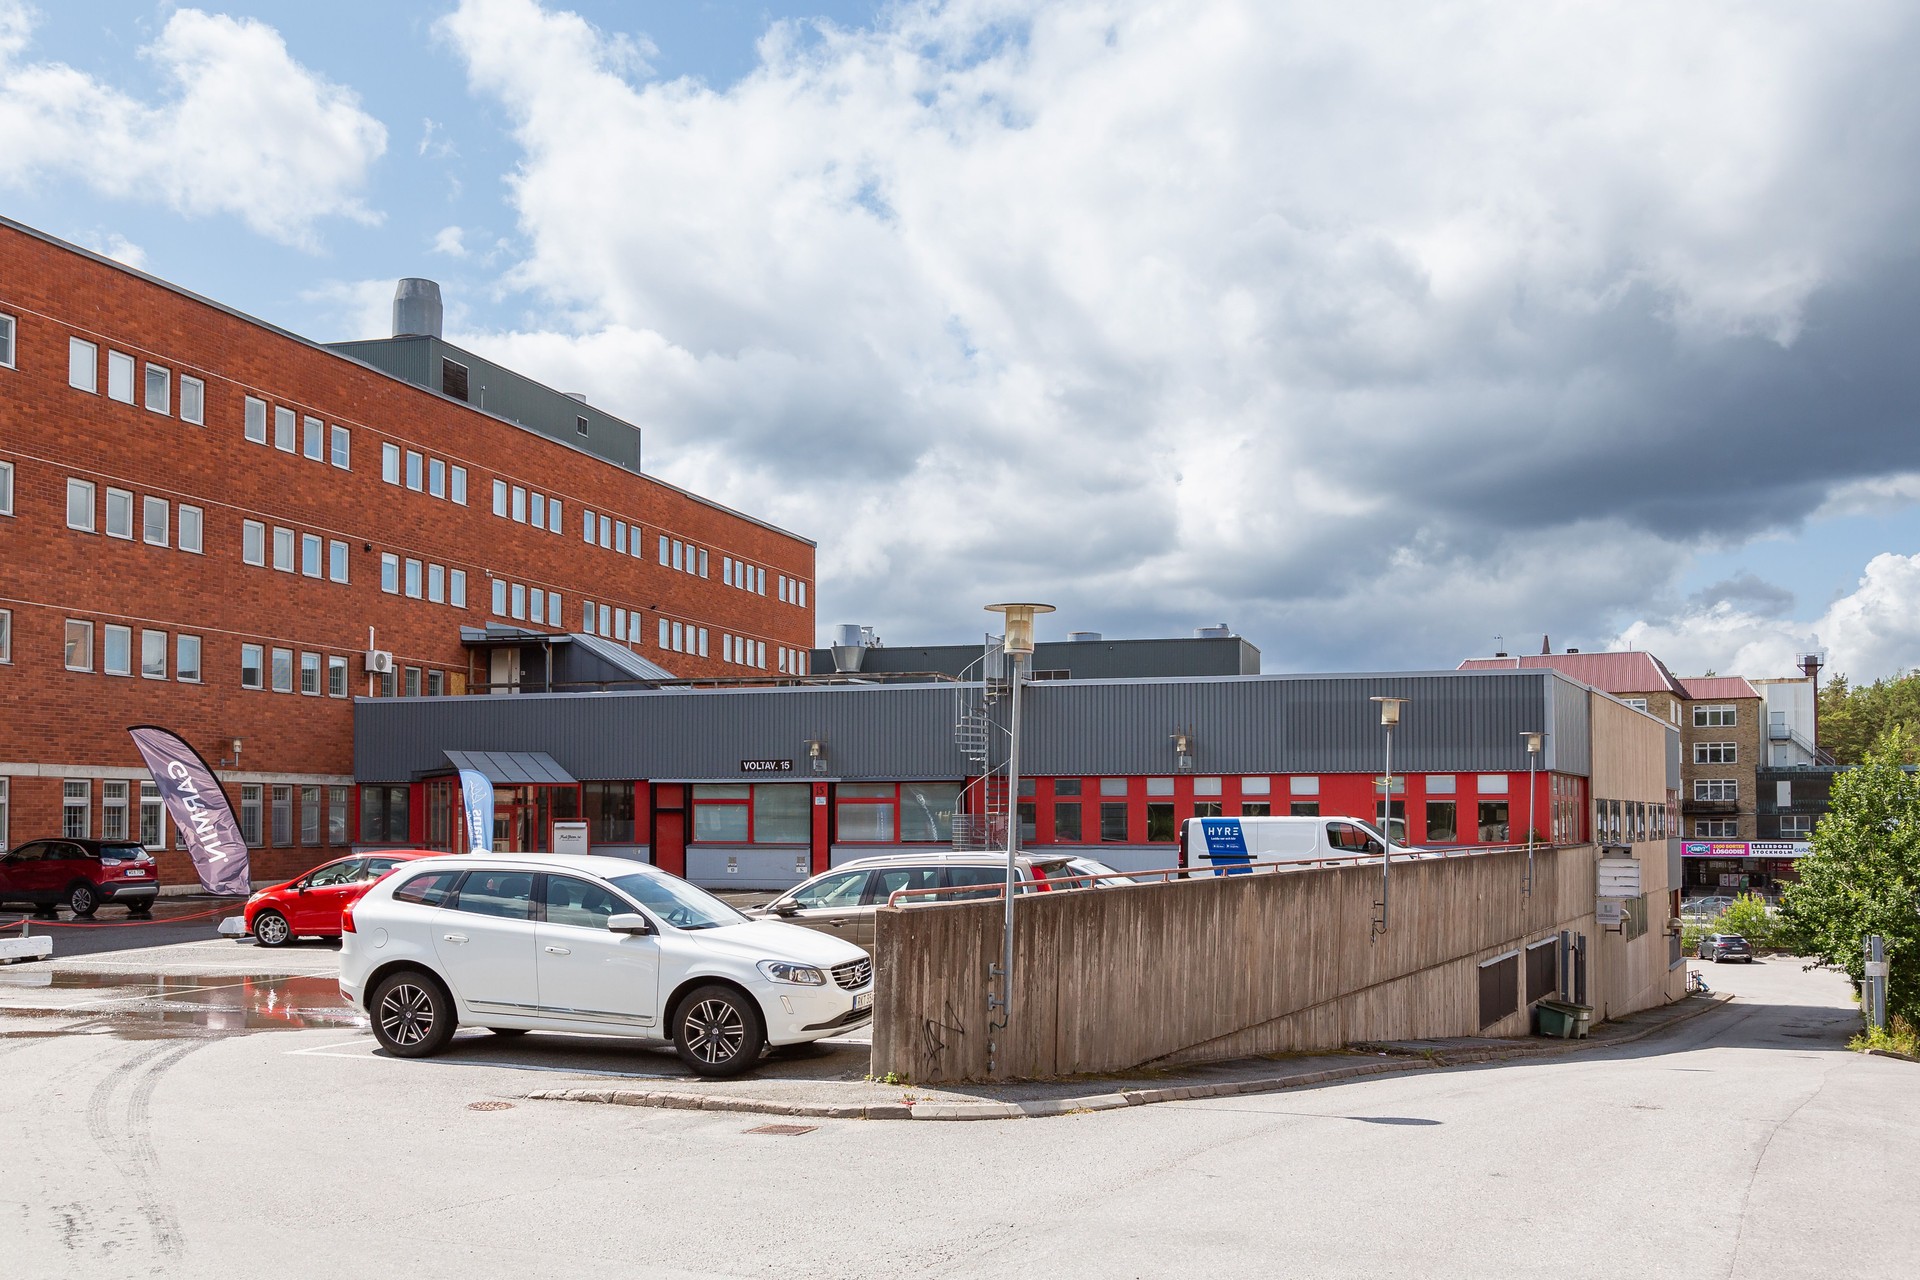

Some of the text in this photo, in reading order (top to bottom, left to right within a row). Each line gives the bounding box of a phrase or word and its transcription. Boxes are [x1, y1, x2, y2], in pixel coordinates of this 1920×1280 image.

[743, 761, 790, 770] VOLTAV. 15
[1208, 827, 1239, 836] HYRE
